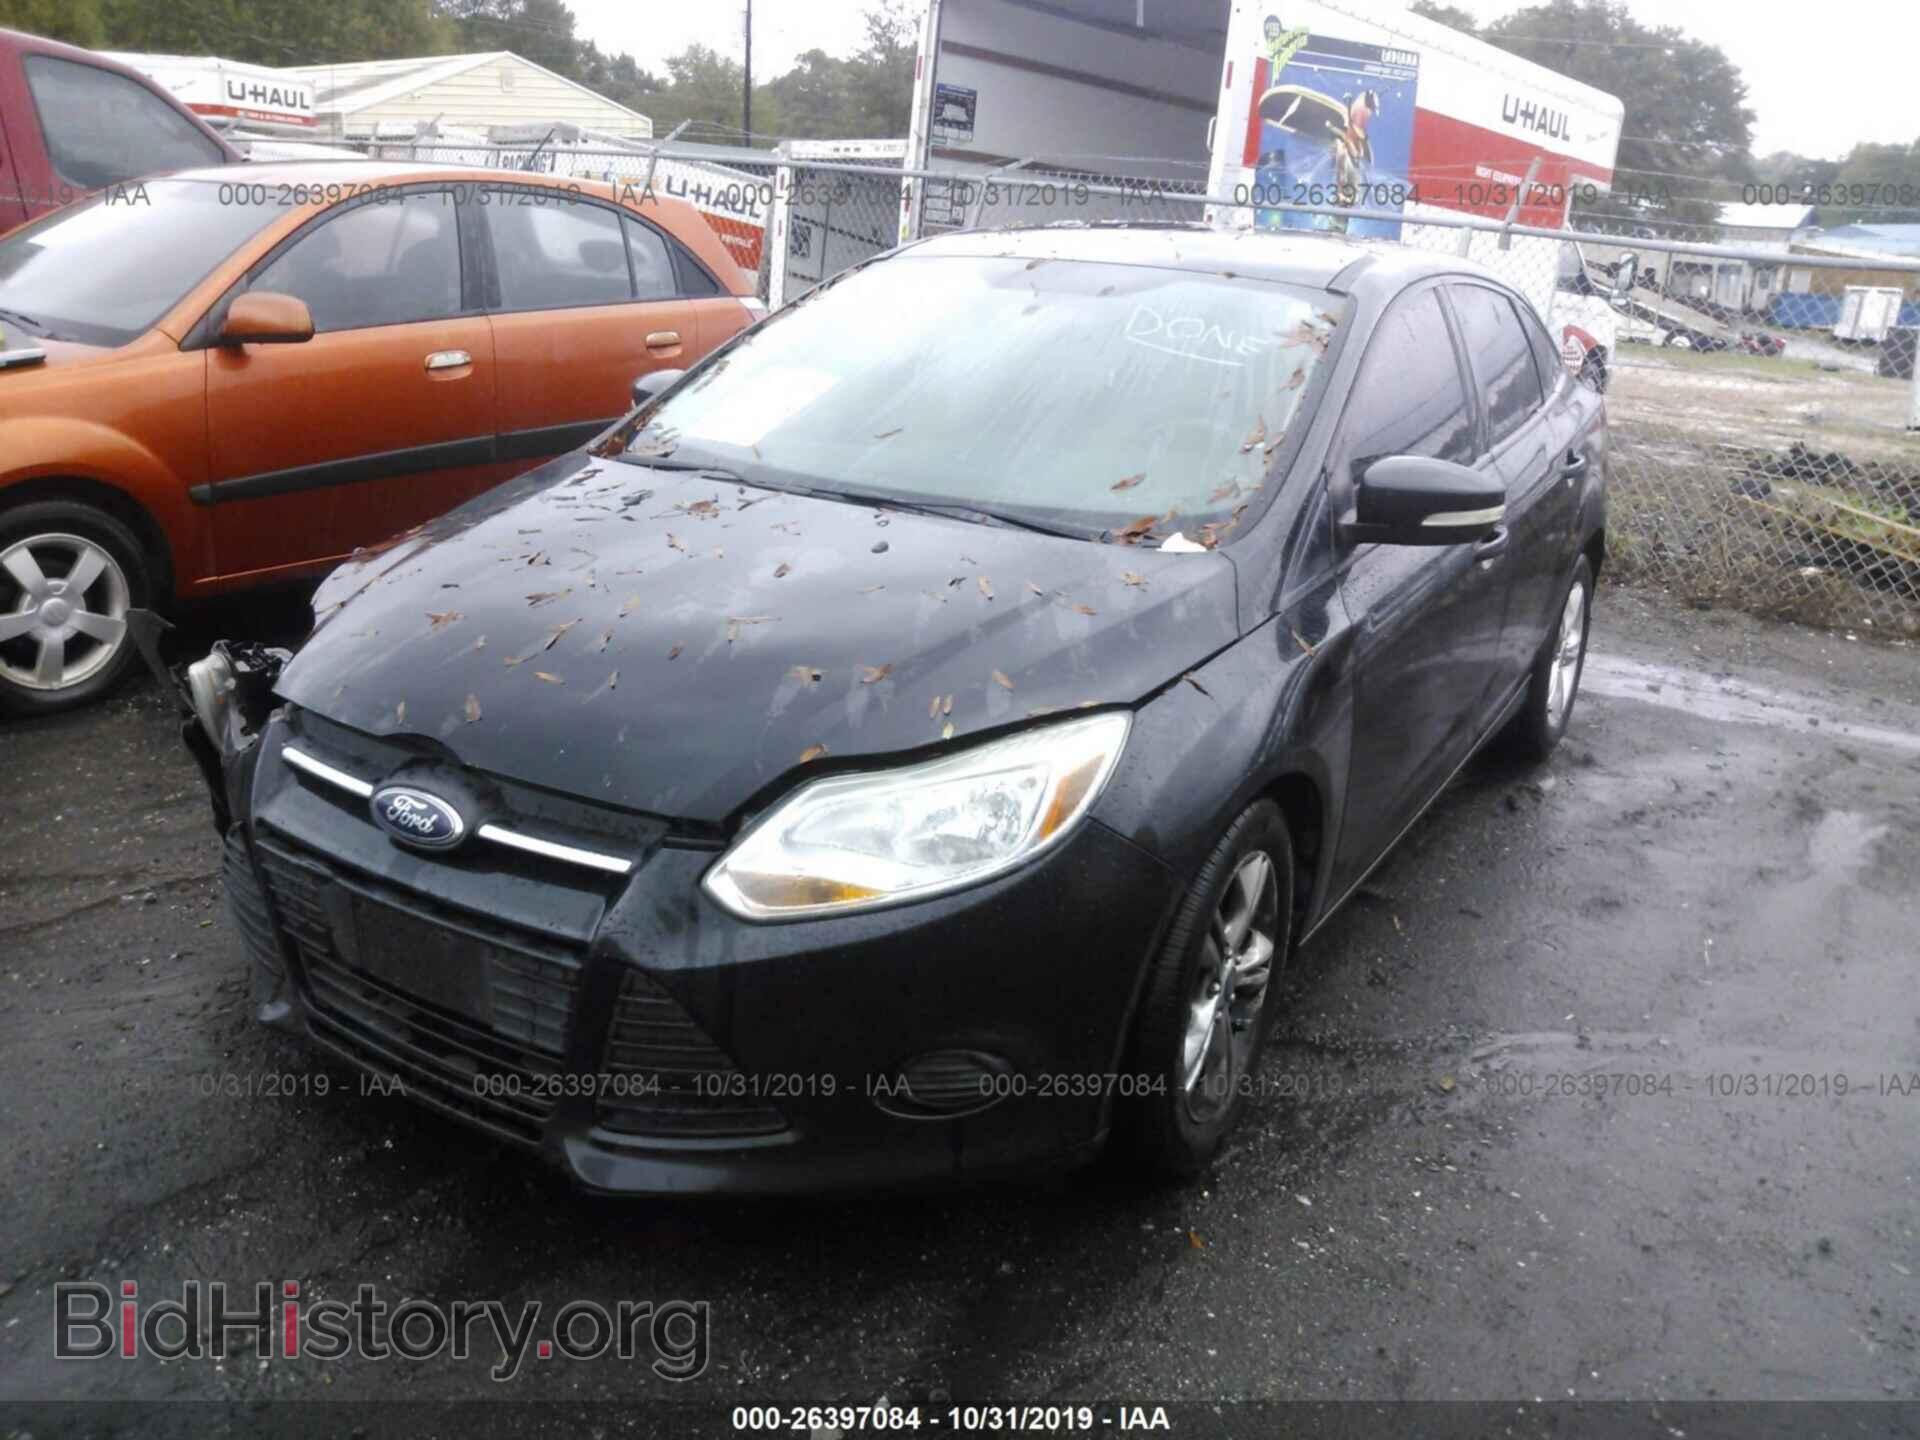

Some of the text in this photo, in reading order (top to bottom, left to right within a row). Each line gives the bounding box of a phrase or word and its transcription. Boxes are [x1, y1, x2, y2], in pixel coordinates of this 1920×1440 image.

[227, 80, 310, 110] U-HAUL
[1502, 93, 1570, 142] U-HAUL
[1125, 304, 1269, 357] DONE
[386, 795, 438, 833] Ford
